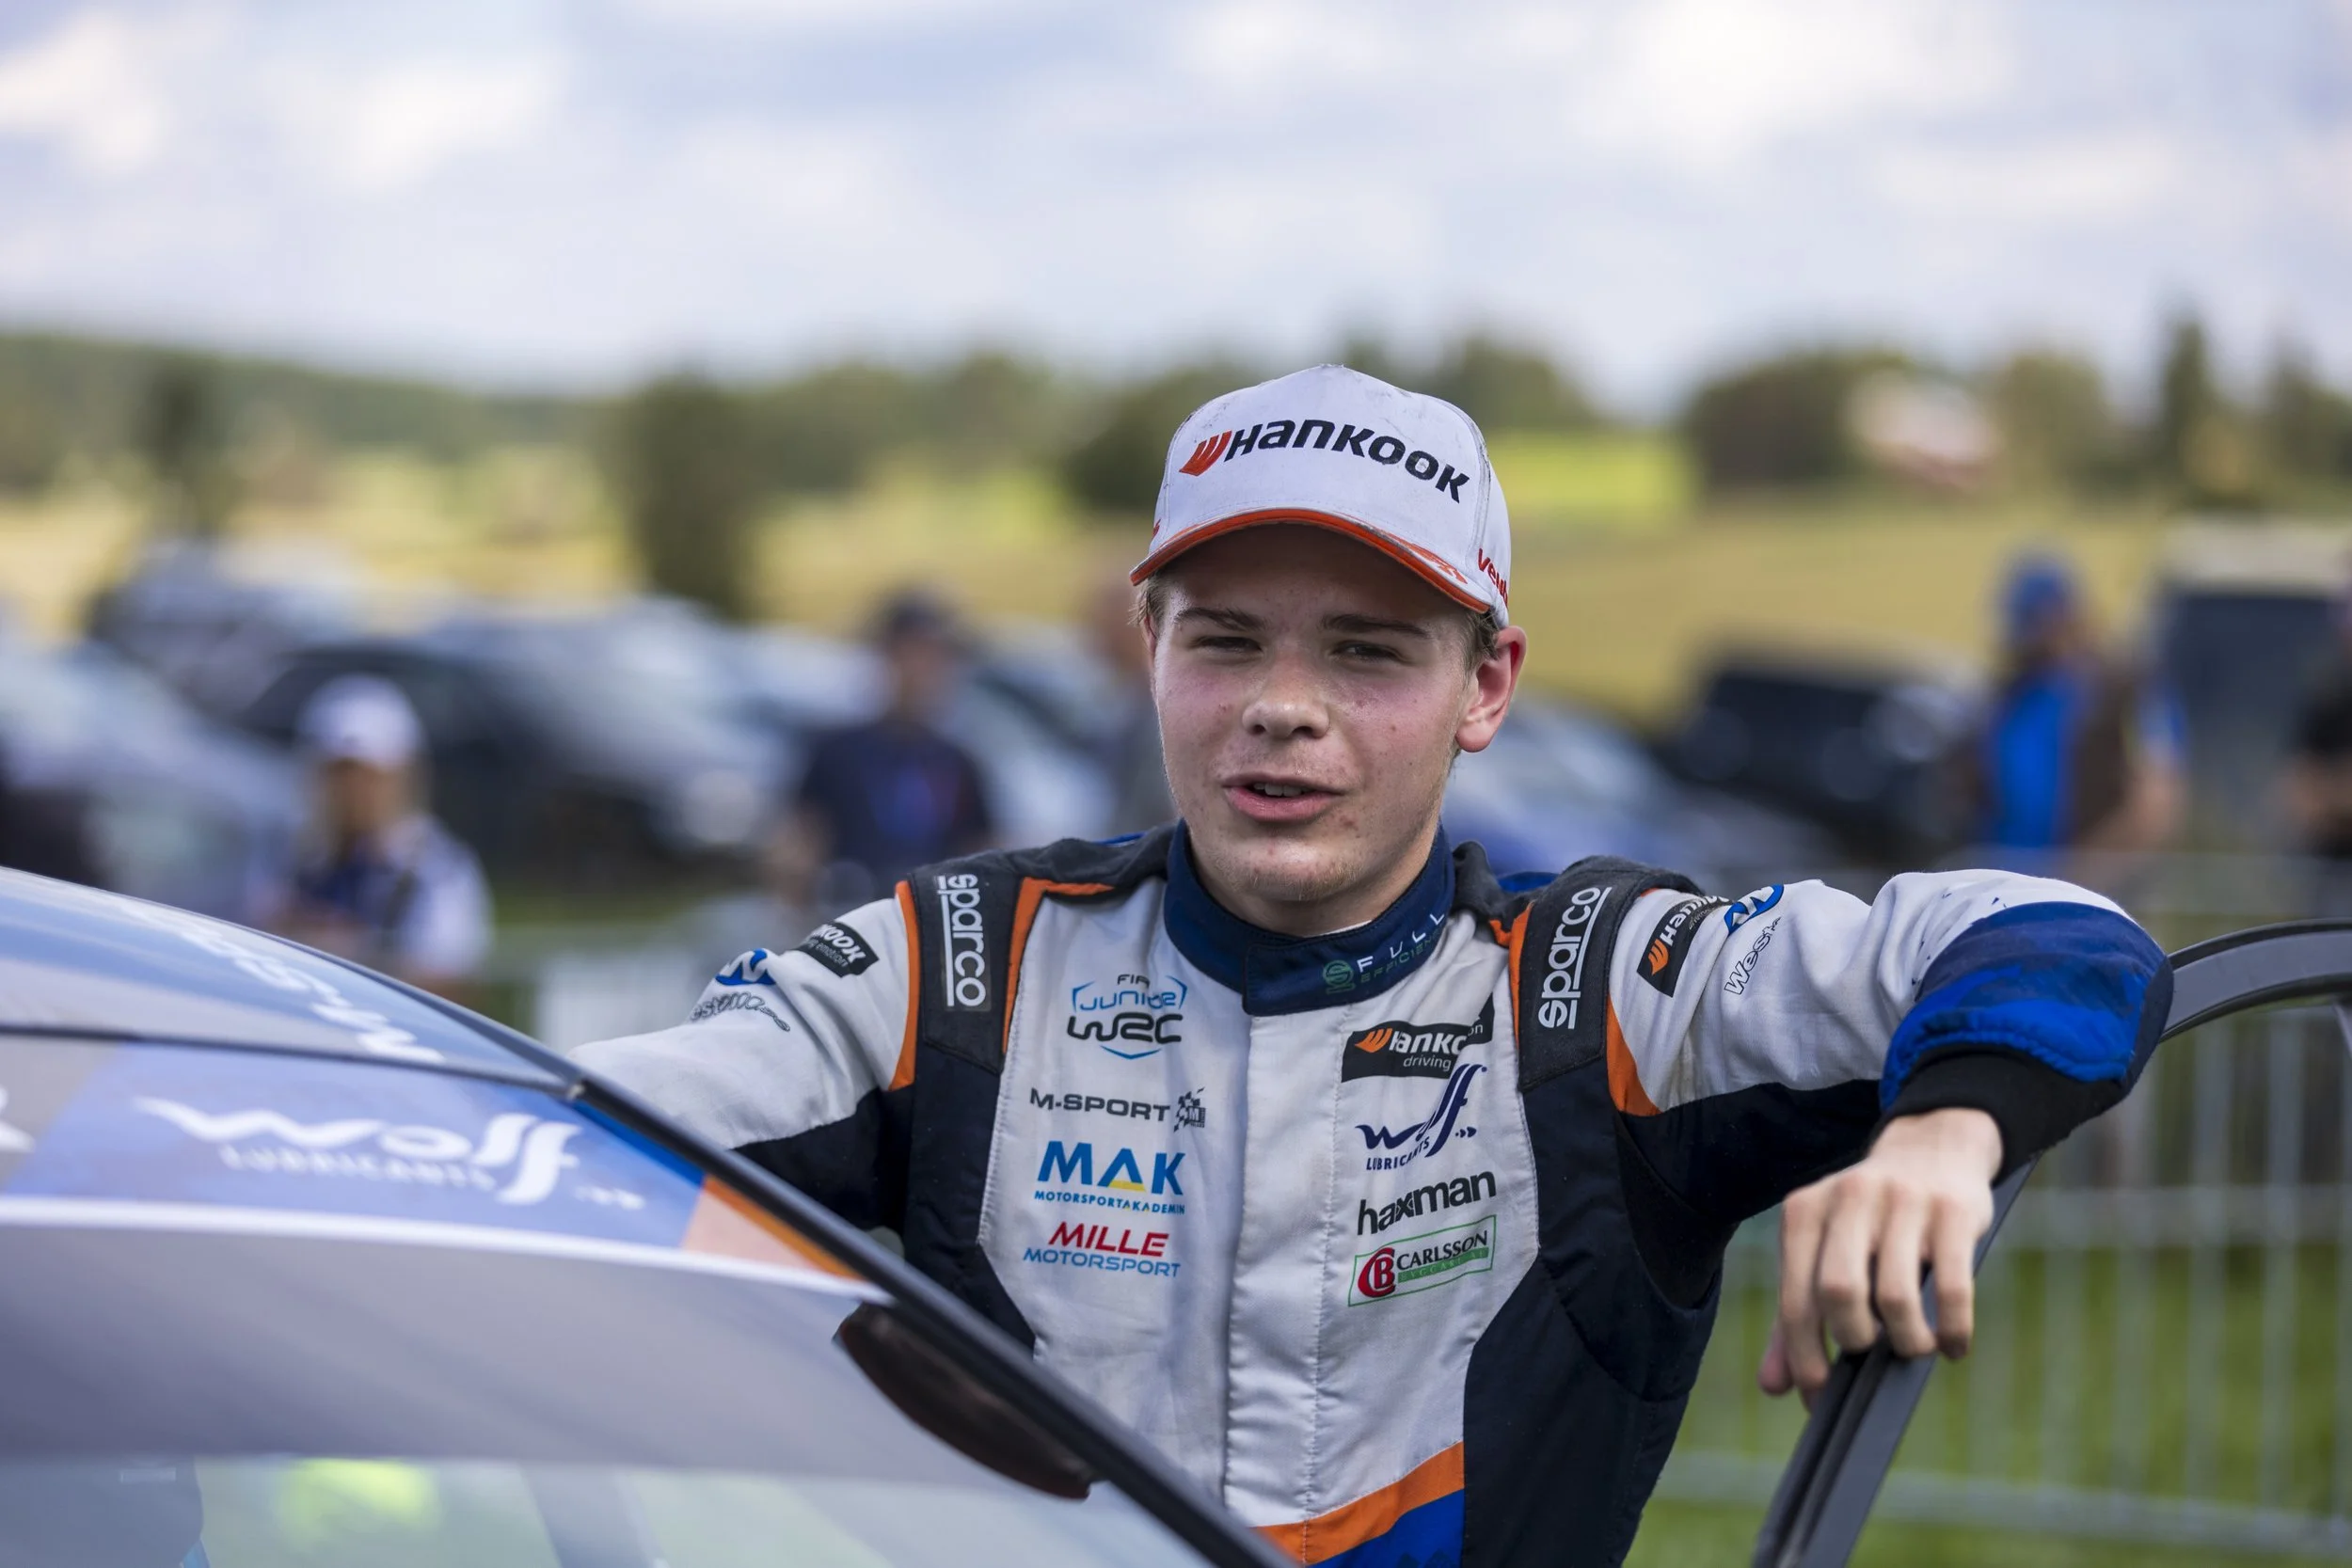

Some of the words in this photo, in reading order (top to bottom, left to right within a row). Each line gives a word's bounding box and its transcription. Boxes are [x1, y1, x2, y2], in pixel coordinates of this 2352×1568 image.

[936, 874, 987, 1007] sparco
[1357, 913, 1445, 973] FULL
[1538, 886, 1613, 1030] sparco
[1117, 974, 1151, 989] FIA
[1067, 1011, 1184, 1044] WRC
[1403, 1054, 1453, 1071] driving
[1029, 1088, 1171, 1121] M-SPORT
[1037, 1140, 1186, 1196] MAK
[1366, 1136, 1430, 1171] LUBRICANTS
[1048, 1221, 1169, 1257] MILLE
[1396, 1230, 1488, 1270] CARLSSON
[1023, 1247, 1182, 1278] MOTORSPORT
